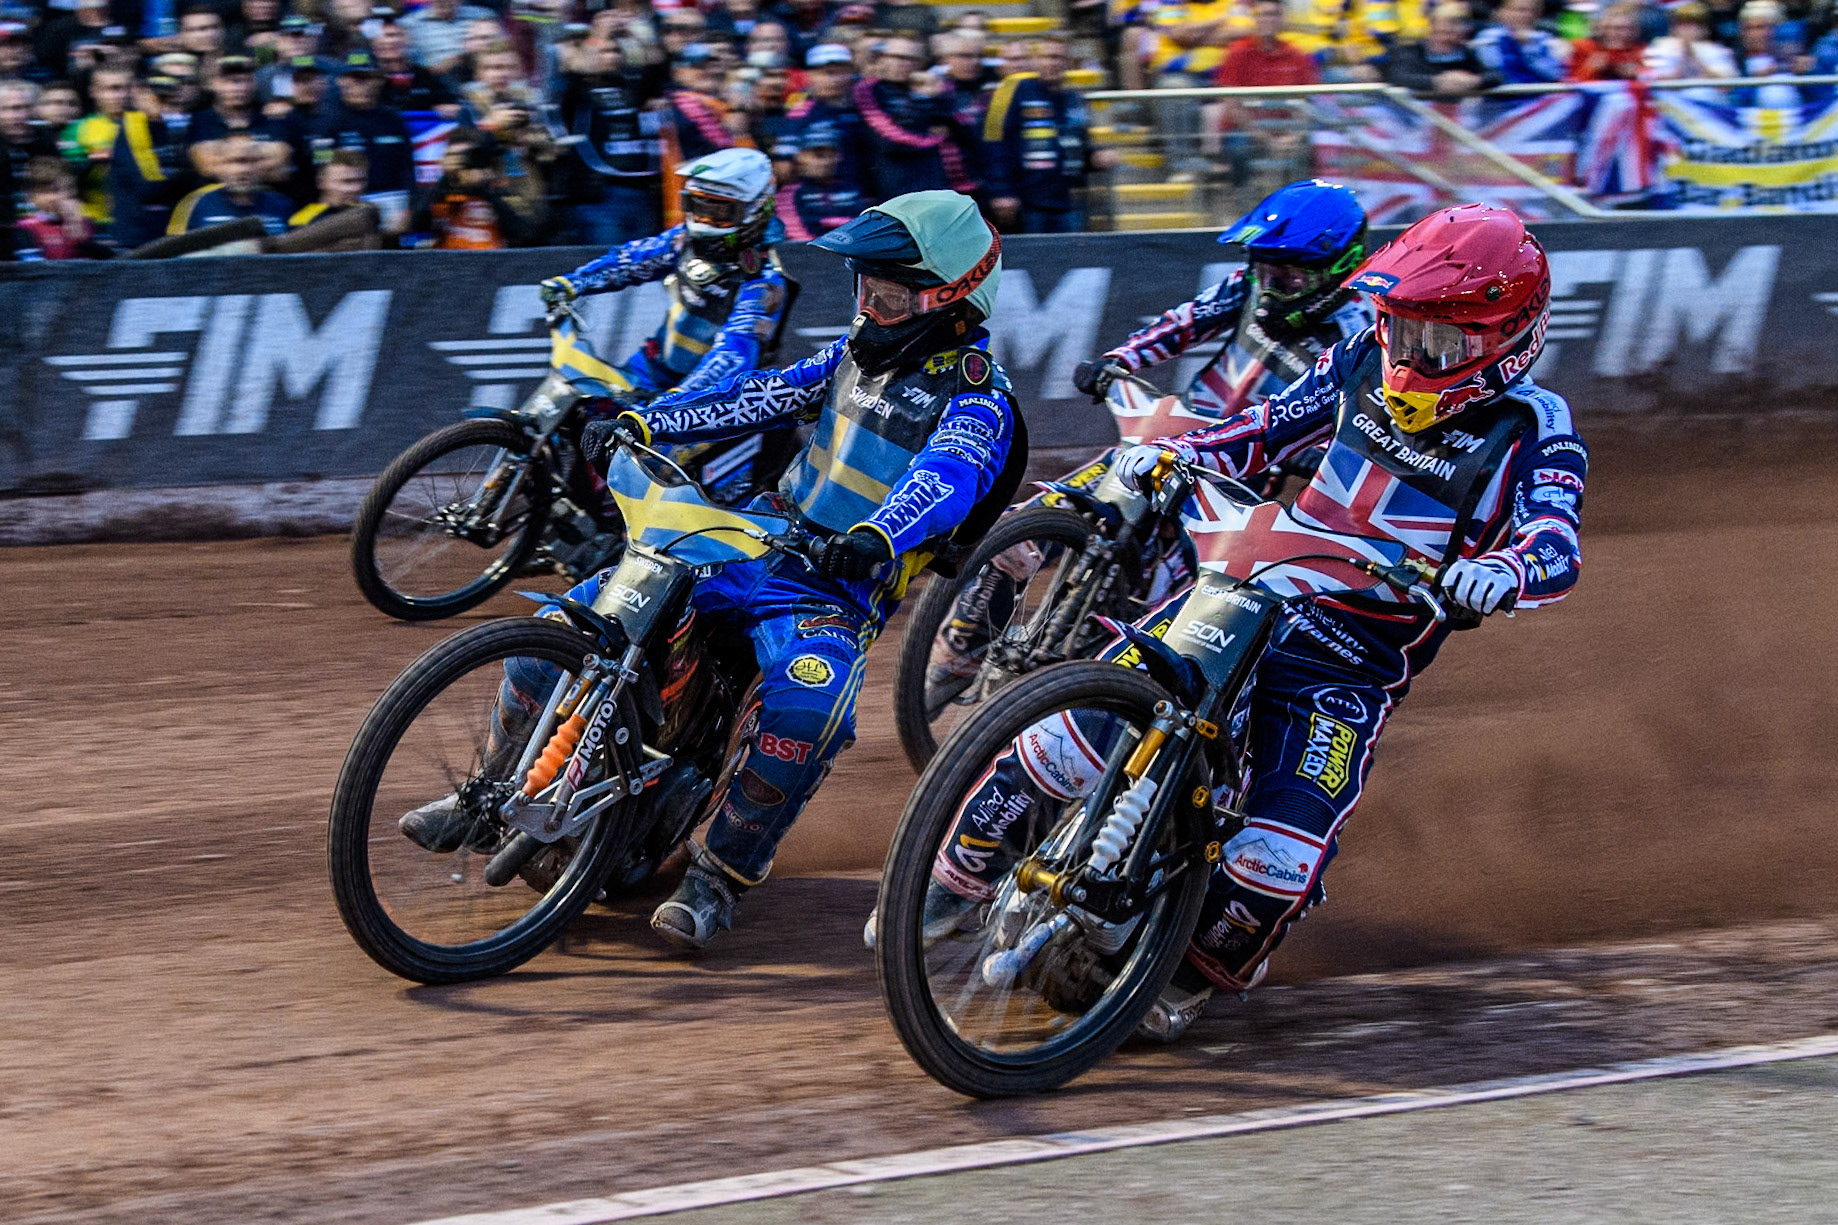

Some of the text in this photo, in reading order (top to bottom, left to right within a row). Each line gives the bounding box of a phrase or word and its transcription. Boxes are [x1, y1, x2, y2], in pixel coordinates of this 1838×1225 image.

[936, 248, 1000, 303] OAKLE
[1501, 277, 1551, 338] OAKLE
[43, 290, 393, 440] FIM
[1498, 325, 1541, 385] Red
[848, 385, 895, 420] SWEDEN
[902, 385, 937, 409] FIM
[1306, 401, 1321, 415] Risk
[1352, 412, 1457, 481] GREAT BRITAIN
[1441, 429, 1486, 454] FIM
[634, 556, 664, 575] SWEDEN
[608, 583, 651, 609] SON
[1201, 585, 1229, 602] GREAT
[1225, 591, 1262, 614] BRITAIN
[1181, 619, 1236, 649] SON
[578, 699, 618, 762] MOTO
[760, 732, 814, 765] BST
[1303, 716, 1336, 777] MAXED
[1029, 732, 1077, 794] ArcticCabins
[1318, 723, 1353, 789] POWER
[971, 785, 1005, 832] Allied
[987, 789, 1036, 842] Mobility
[1234, 853, 1308, 885] ArcticCabins
